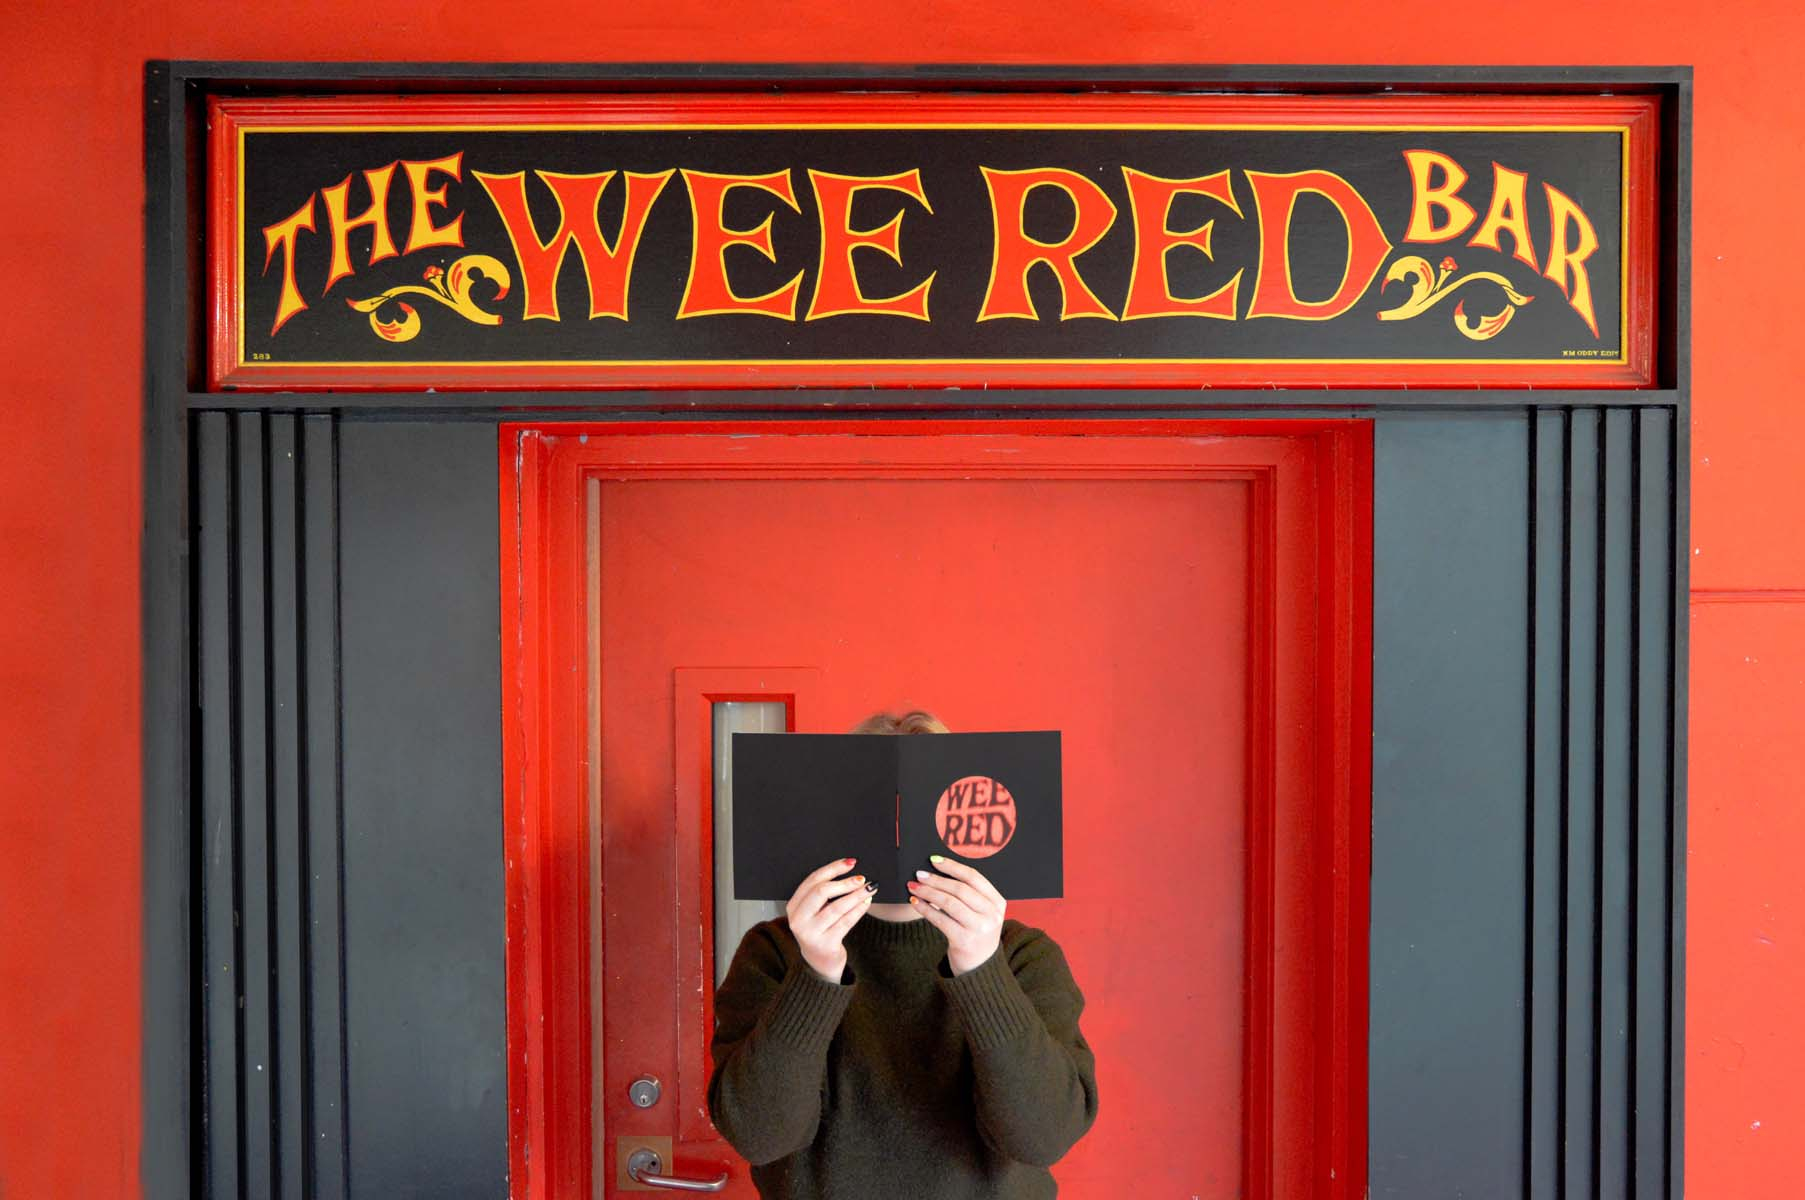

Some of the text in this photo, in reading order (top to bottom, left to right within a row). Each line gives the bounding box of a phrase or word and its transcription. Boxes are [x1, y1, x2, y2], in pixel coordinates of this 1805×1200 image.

[263, 149, 1600, 340] THE WEE RED BAR
[947, 779, 1010, 811] WEE
[943, 812, 1013, 847] RED
